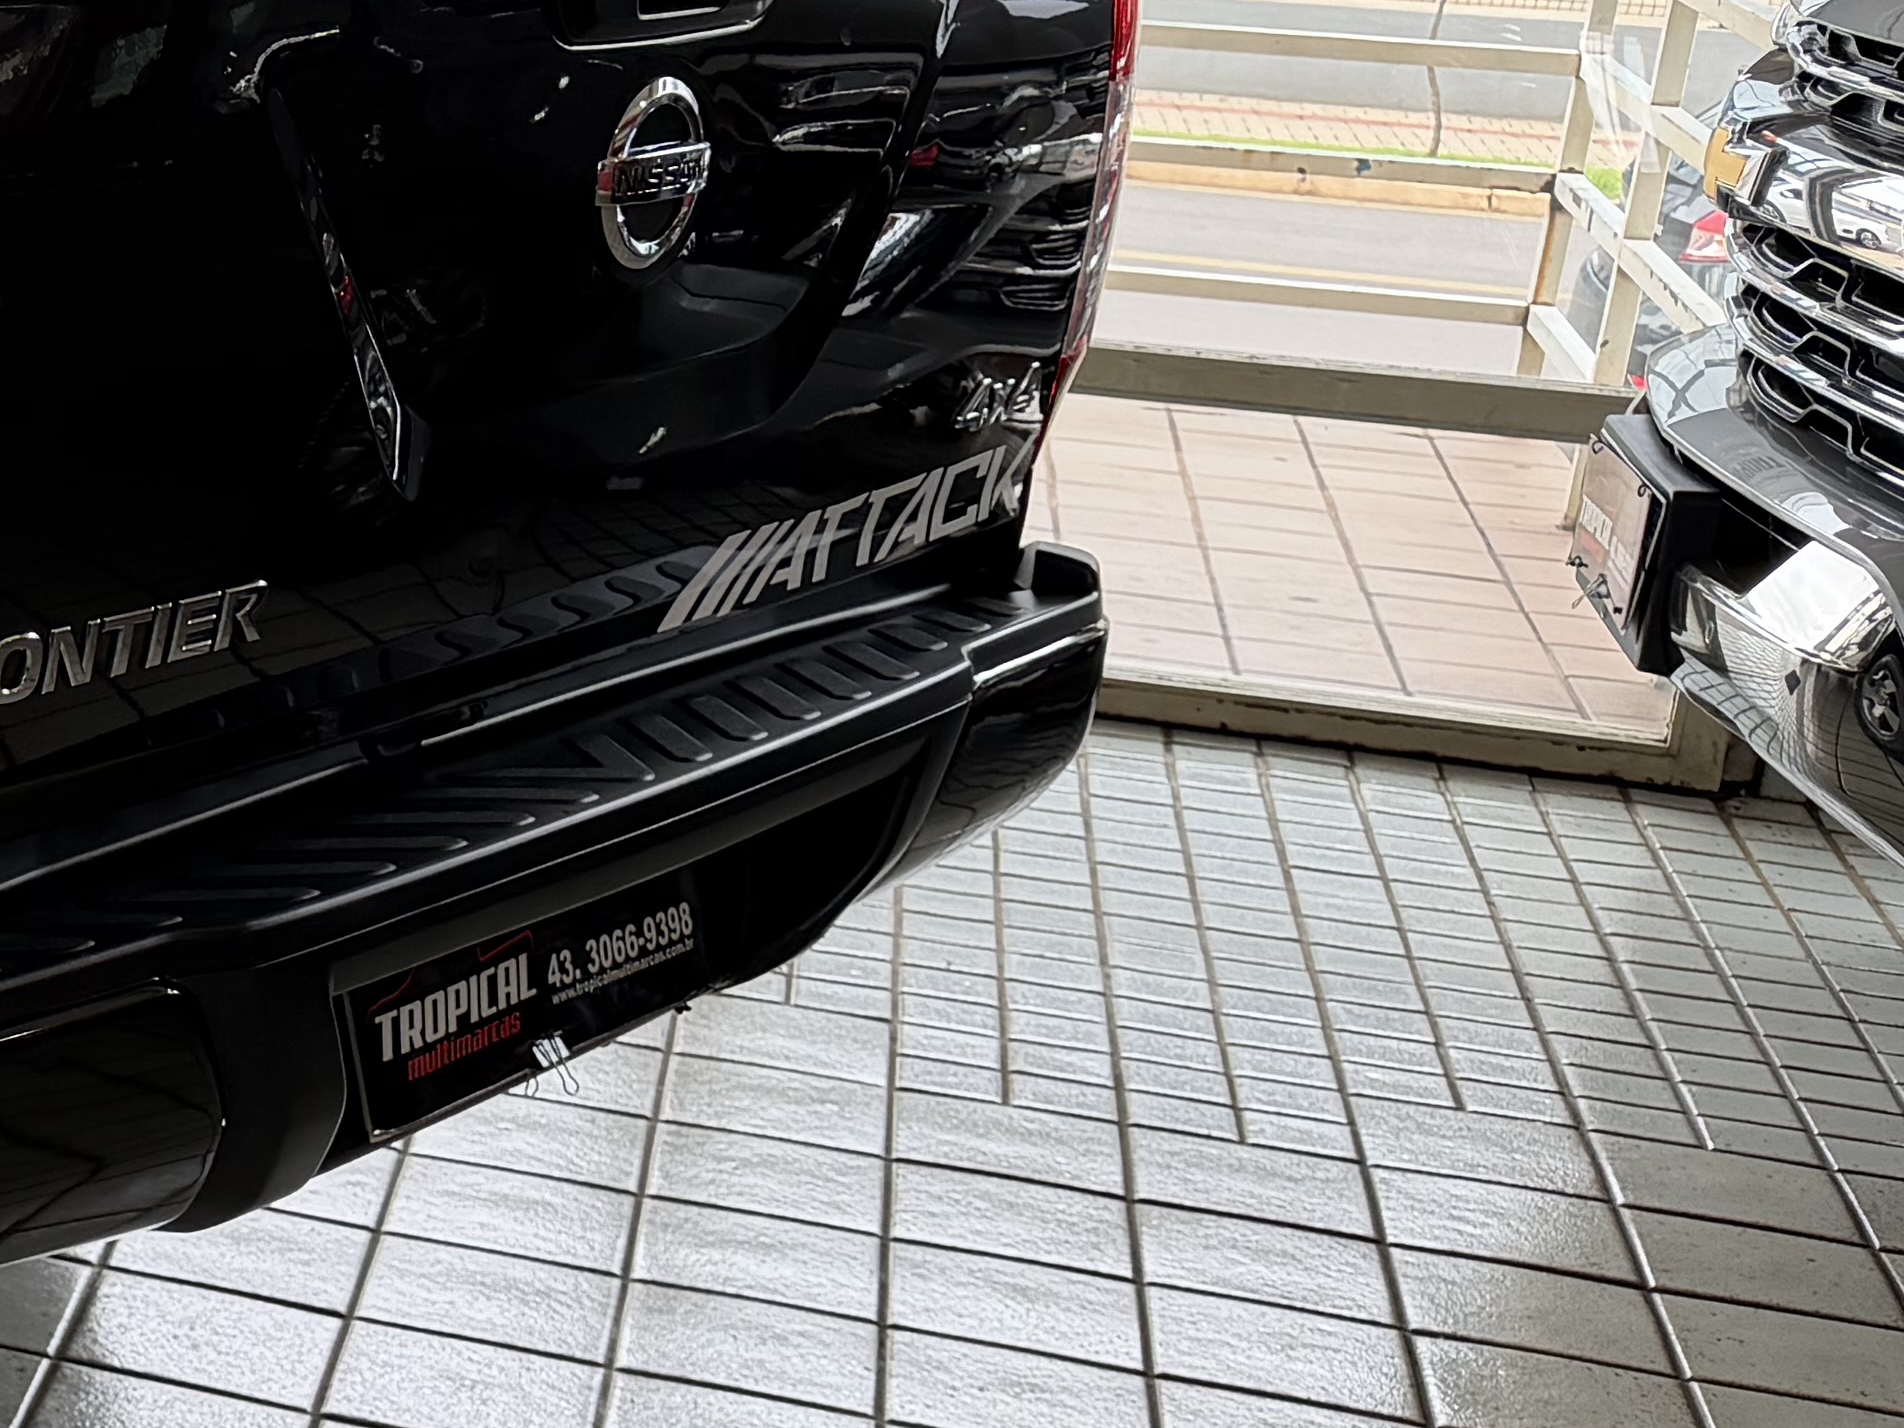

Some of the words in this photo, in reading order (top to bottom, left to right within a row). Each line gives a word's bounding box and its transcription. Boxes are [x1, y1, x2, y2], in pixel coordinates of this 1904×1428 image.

[547, 948, 582, 988] 43.
[585, 901, 694, 974] 3066-9398
[374, 952, 537, 1062] TROPICAL
[406, 1010, 522, 1082] multimarcas
